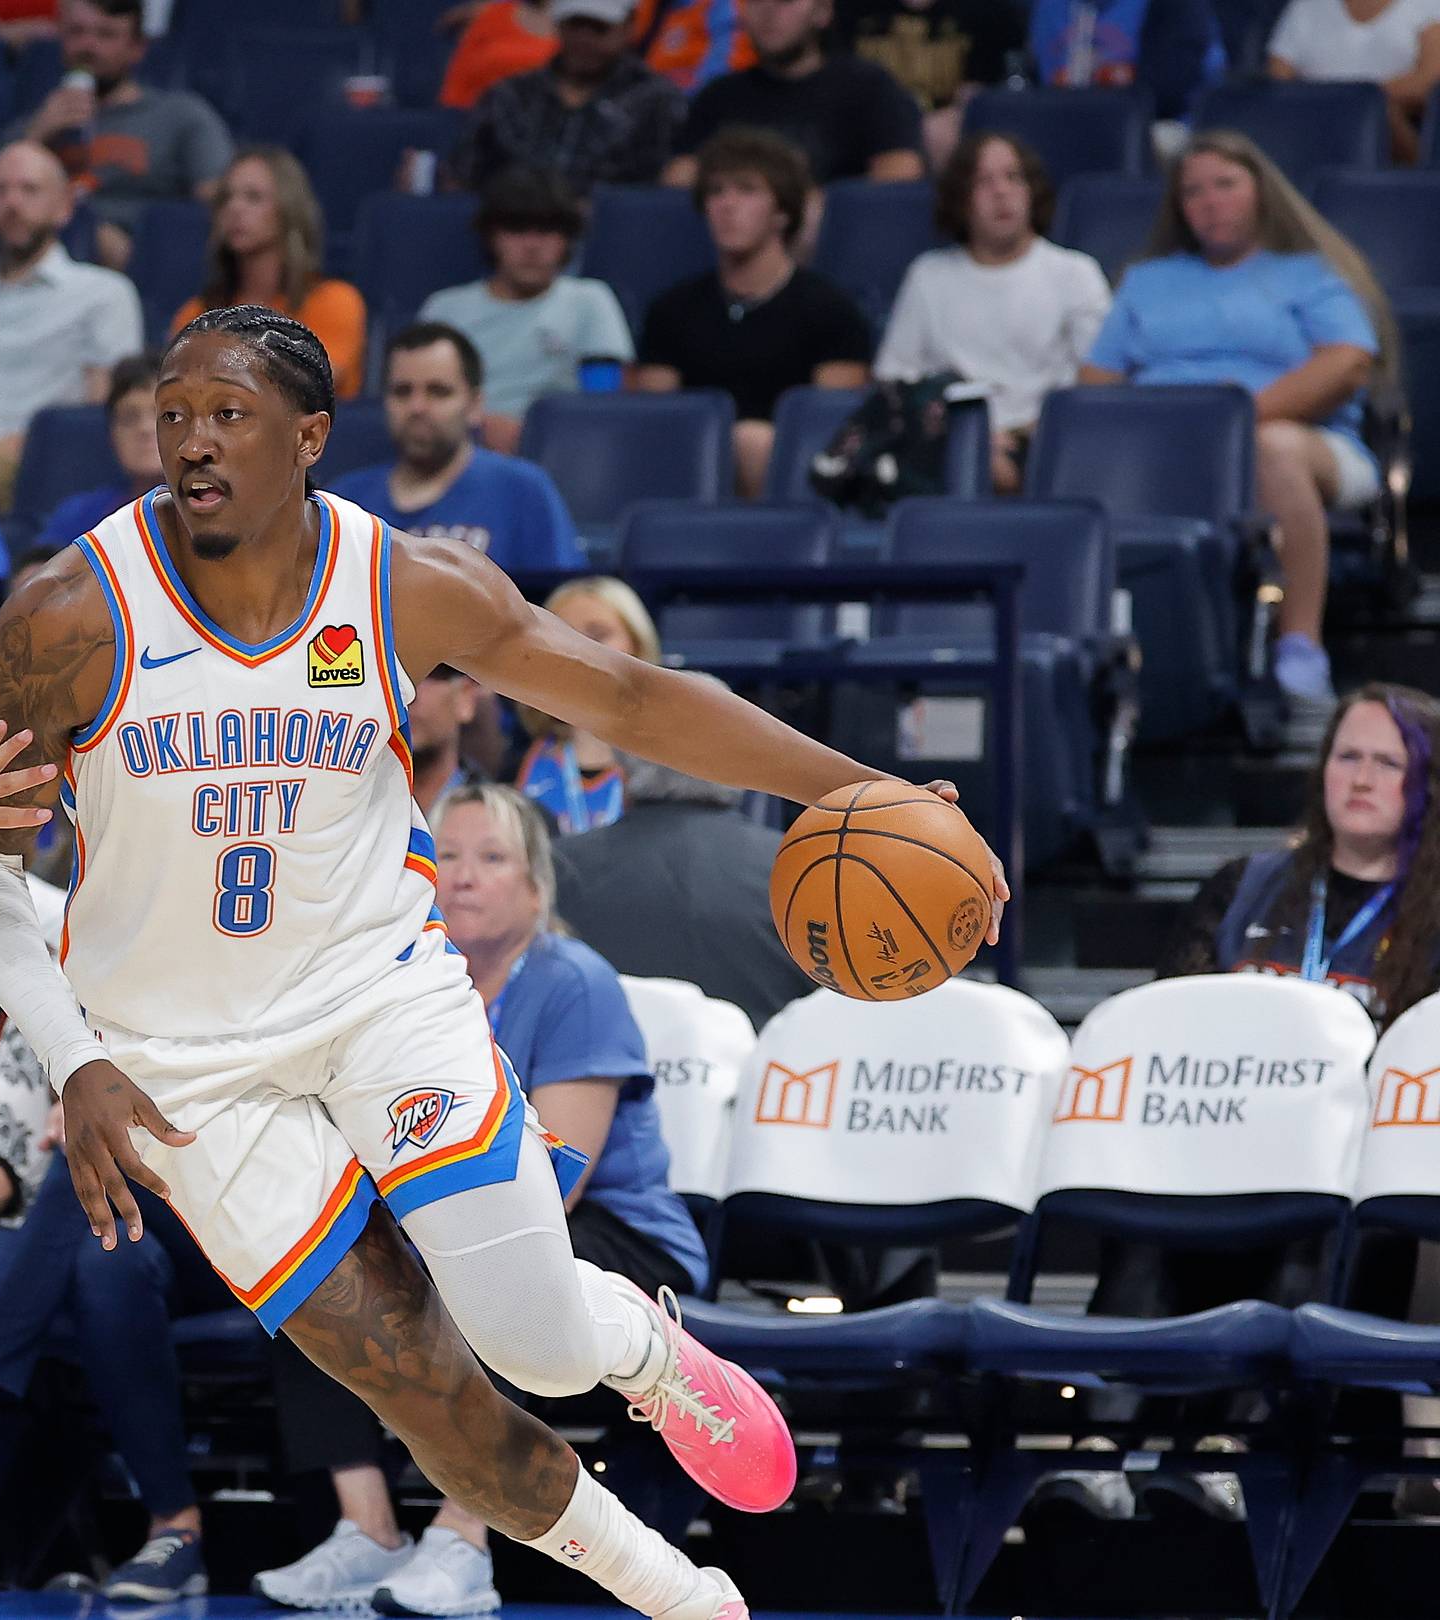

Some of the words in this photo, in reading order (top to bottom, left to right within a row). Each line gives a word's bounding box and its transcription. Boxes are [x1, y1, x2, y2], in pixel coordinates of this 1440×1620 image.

[117, 707, 380, 778] OKLAHOMA
[192, 778, 307, 837] CITY
[212, 841, 277, 938] 8
[392, 1095, 439, 1148] OKC
